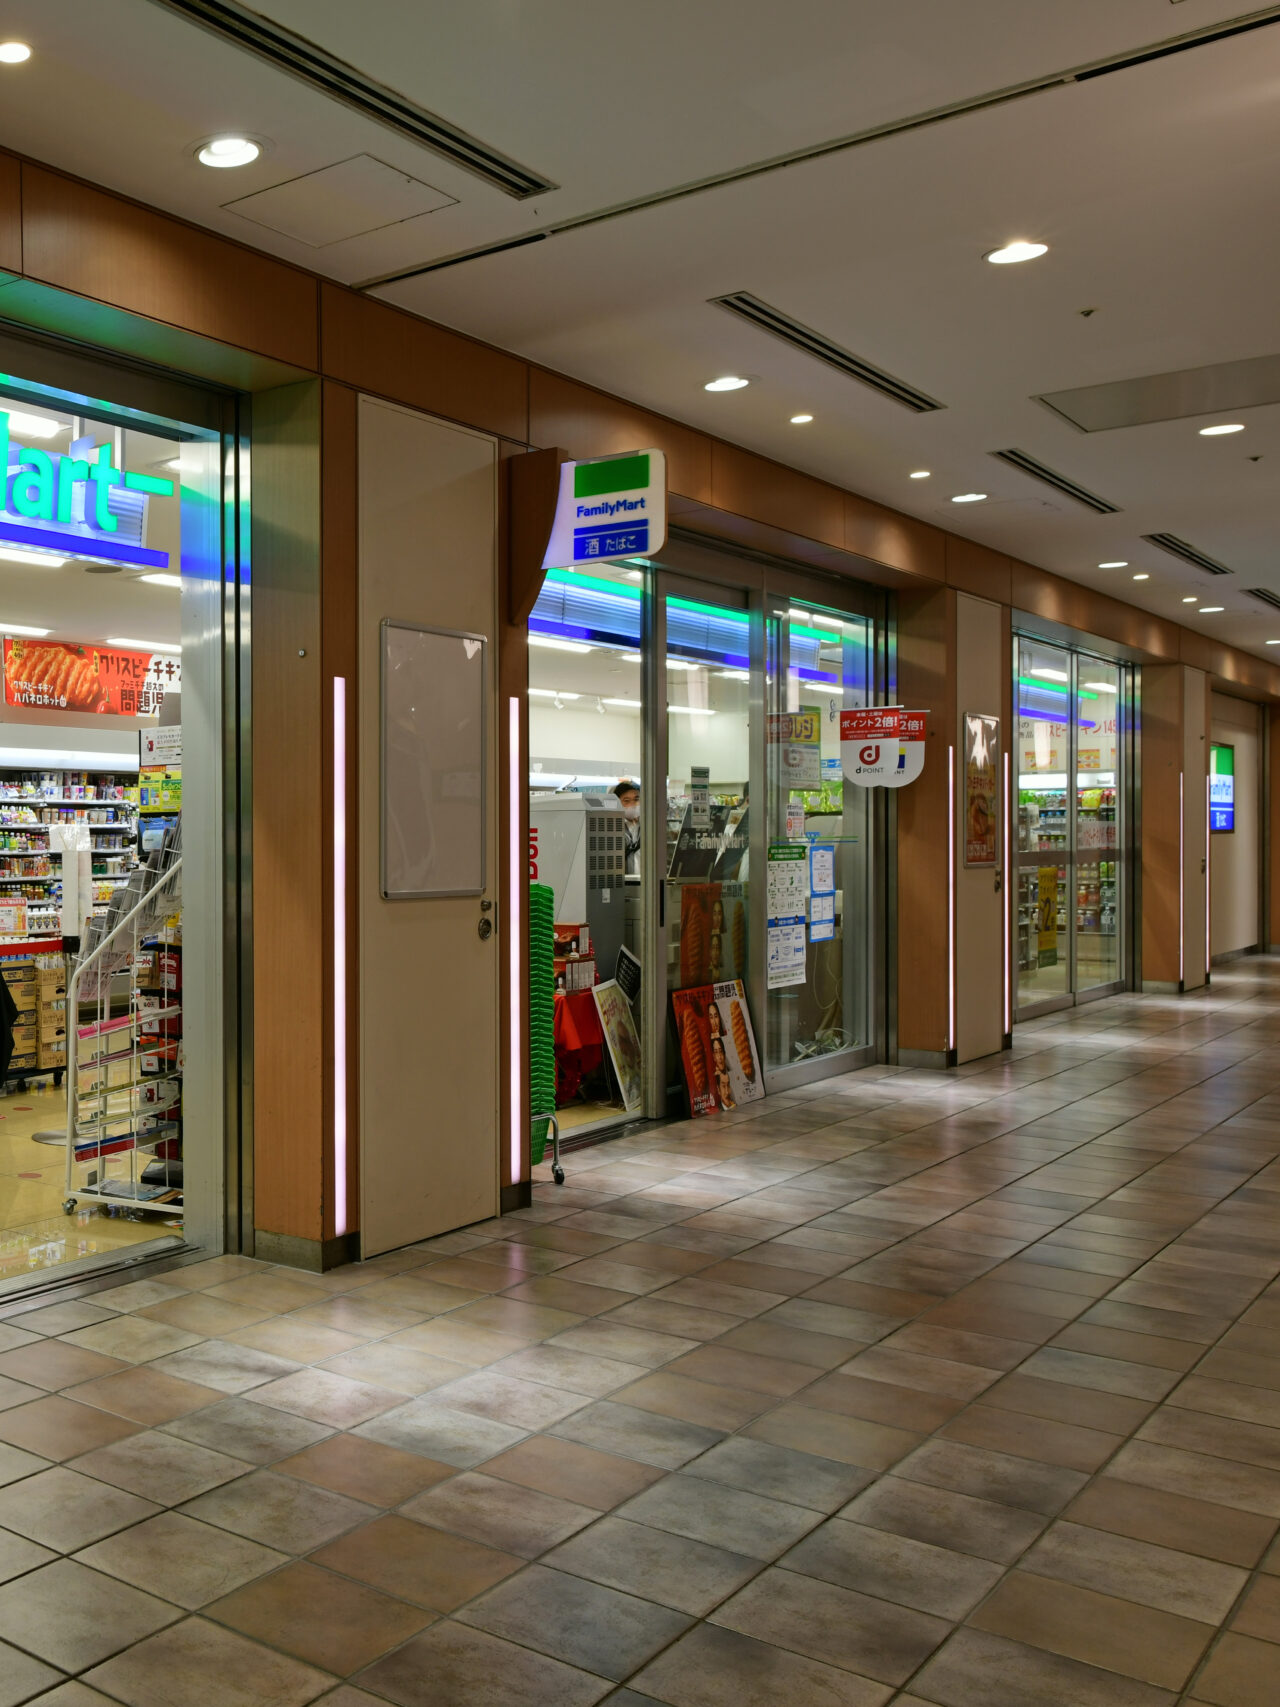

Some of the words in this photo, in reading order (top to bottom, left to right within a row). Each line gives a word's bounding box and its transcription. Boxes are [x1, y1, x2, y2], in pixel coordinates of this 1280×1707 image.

[576, 497, 646, 517] FamilyMart
[585, 537, 600, 555] 酒
[605, 535, 637, 552] たばこ
[841, 716, 898, 729] ポイント2倍!
